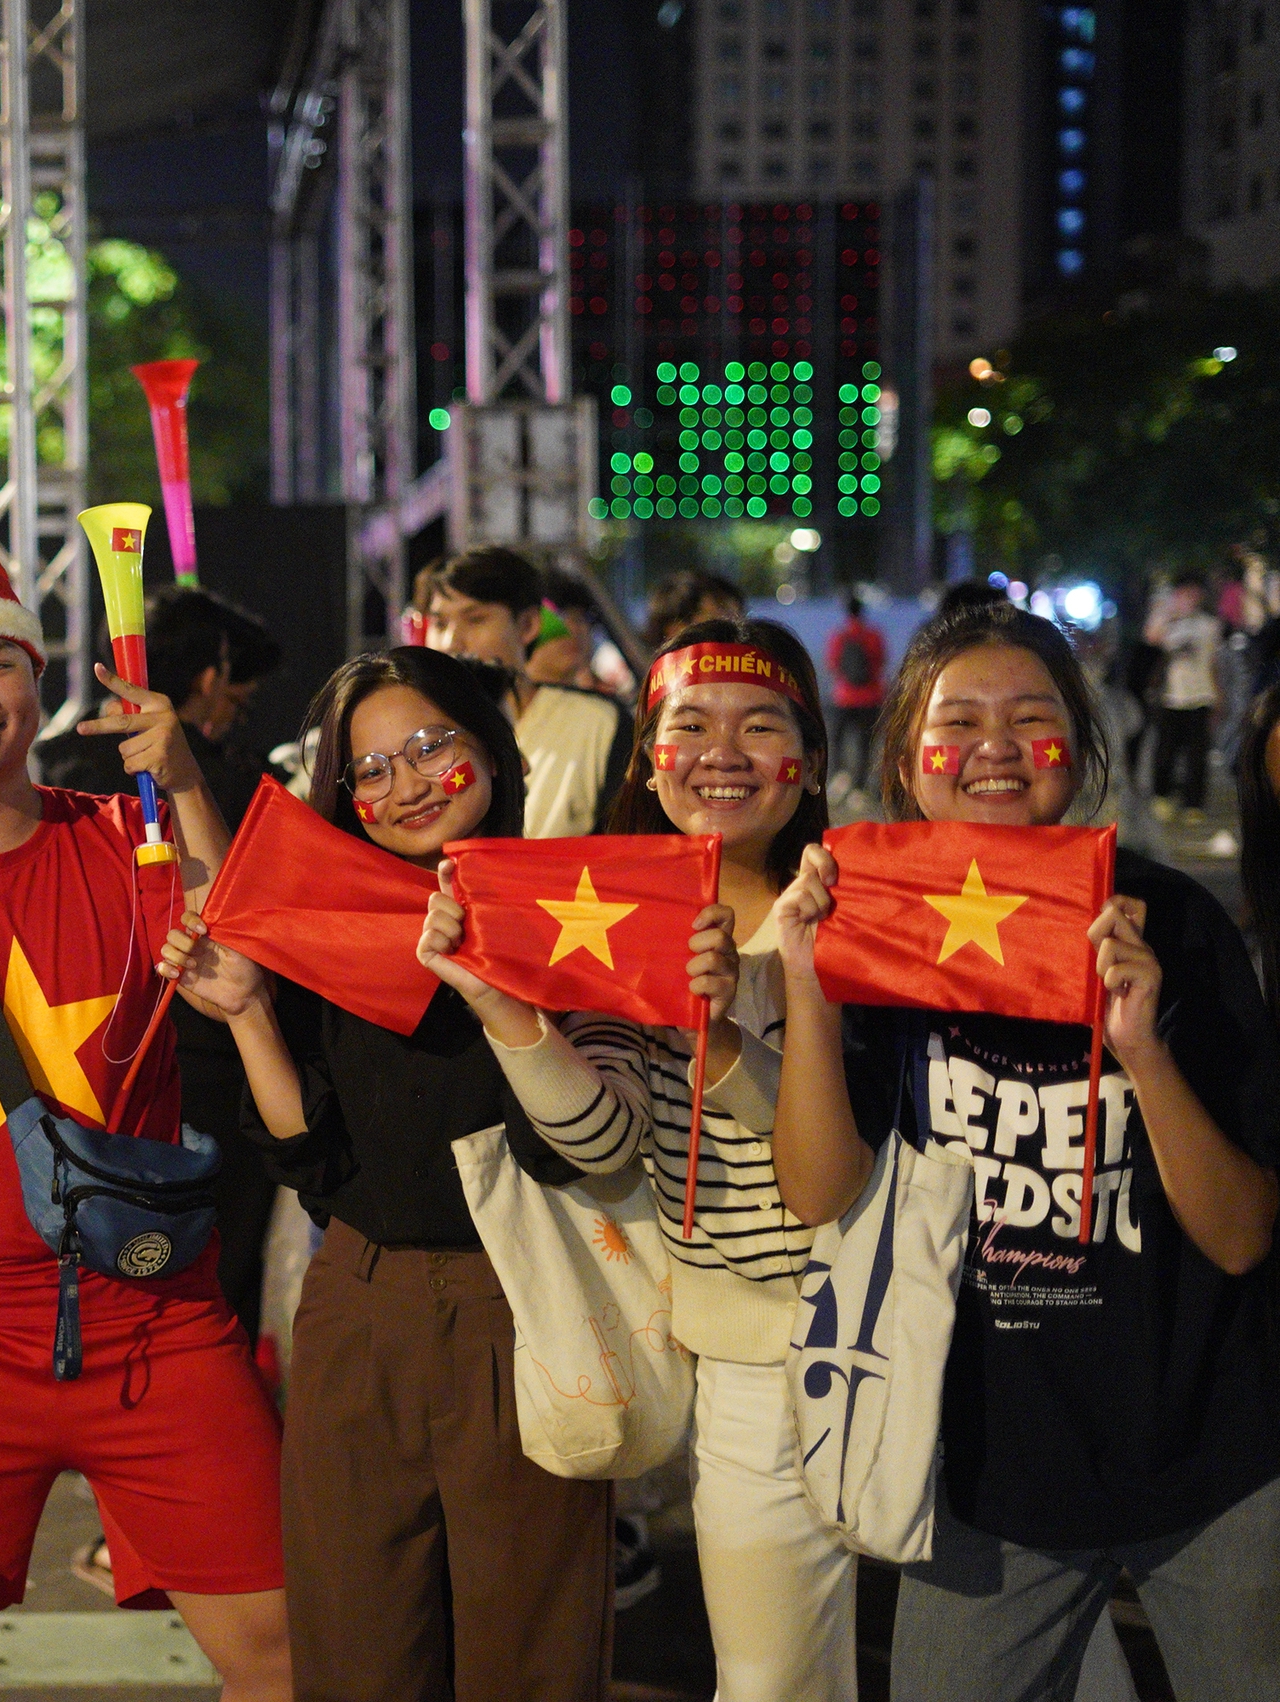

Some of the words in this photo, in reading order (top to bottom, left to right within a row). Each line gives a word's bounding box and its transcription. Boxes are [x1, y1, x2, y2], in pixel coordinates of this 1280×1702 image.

[699, 651, 772, 678] CHIẾN
[965, 1038, 1008, 1066] UICK
[1079, 1298, 1103, 1306] ALONE
